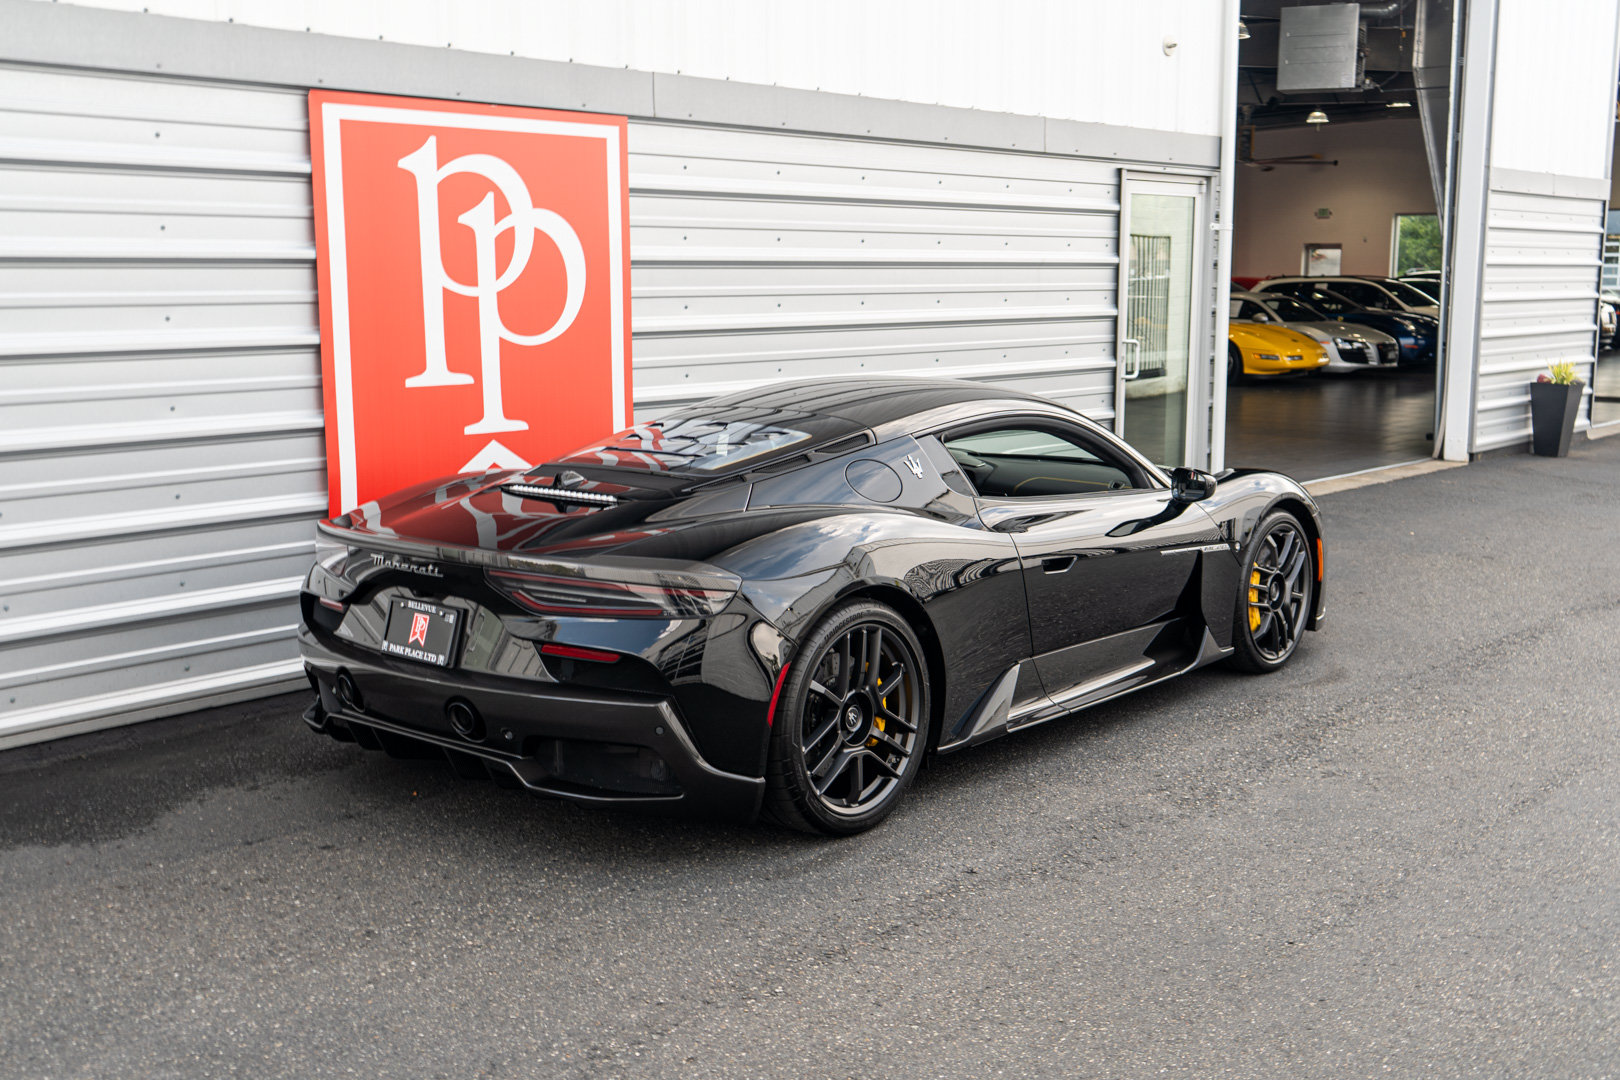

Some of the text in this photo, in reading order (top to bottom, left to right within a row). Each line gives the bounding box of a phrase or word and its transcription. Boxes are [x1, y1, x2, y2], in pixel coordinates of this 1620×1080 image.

[370, 552, 443, 577] Maserati
[407, 600, 436, 613] BELLEVUE
[389, 643, 404, 654] PARK
[404, 647, 423, 658] PLACE
[424, 651, 437, 662] LTD
